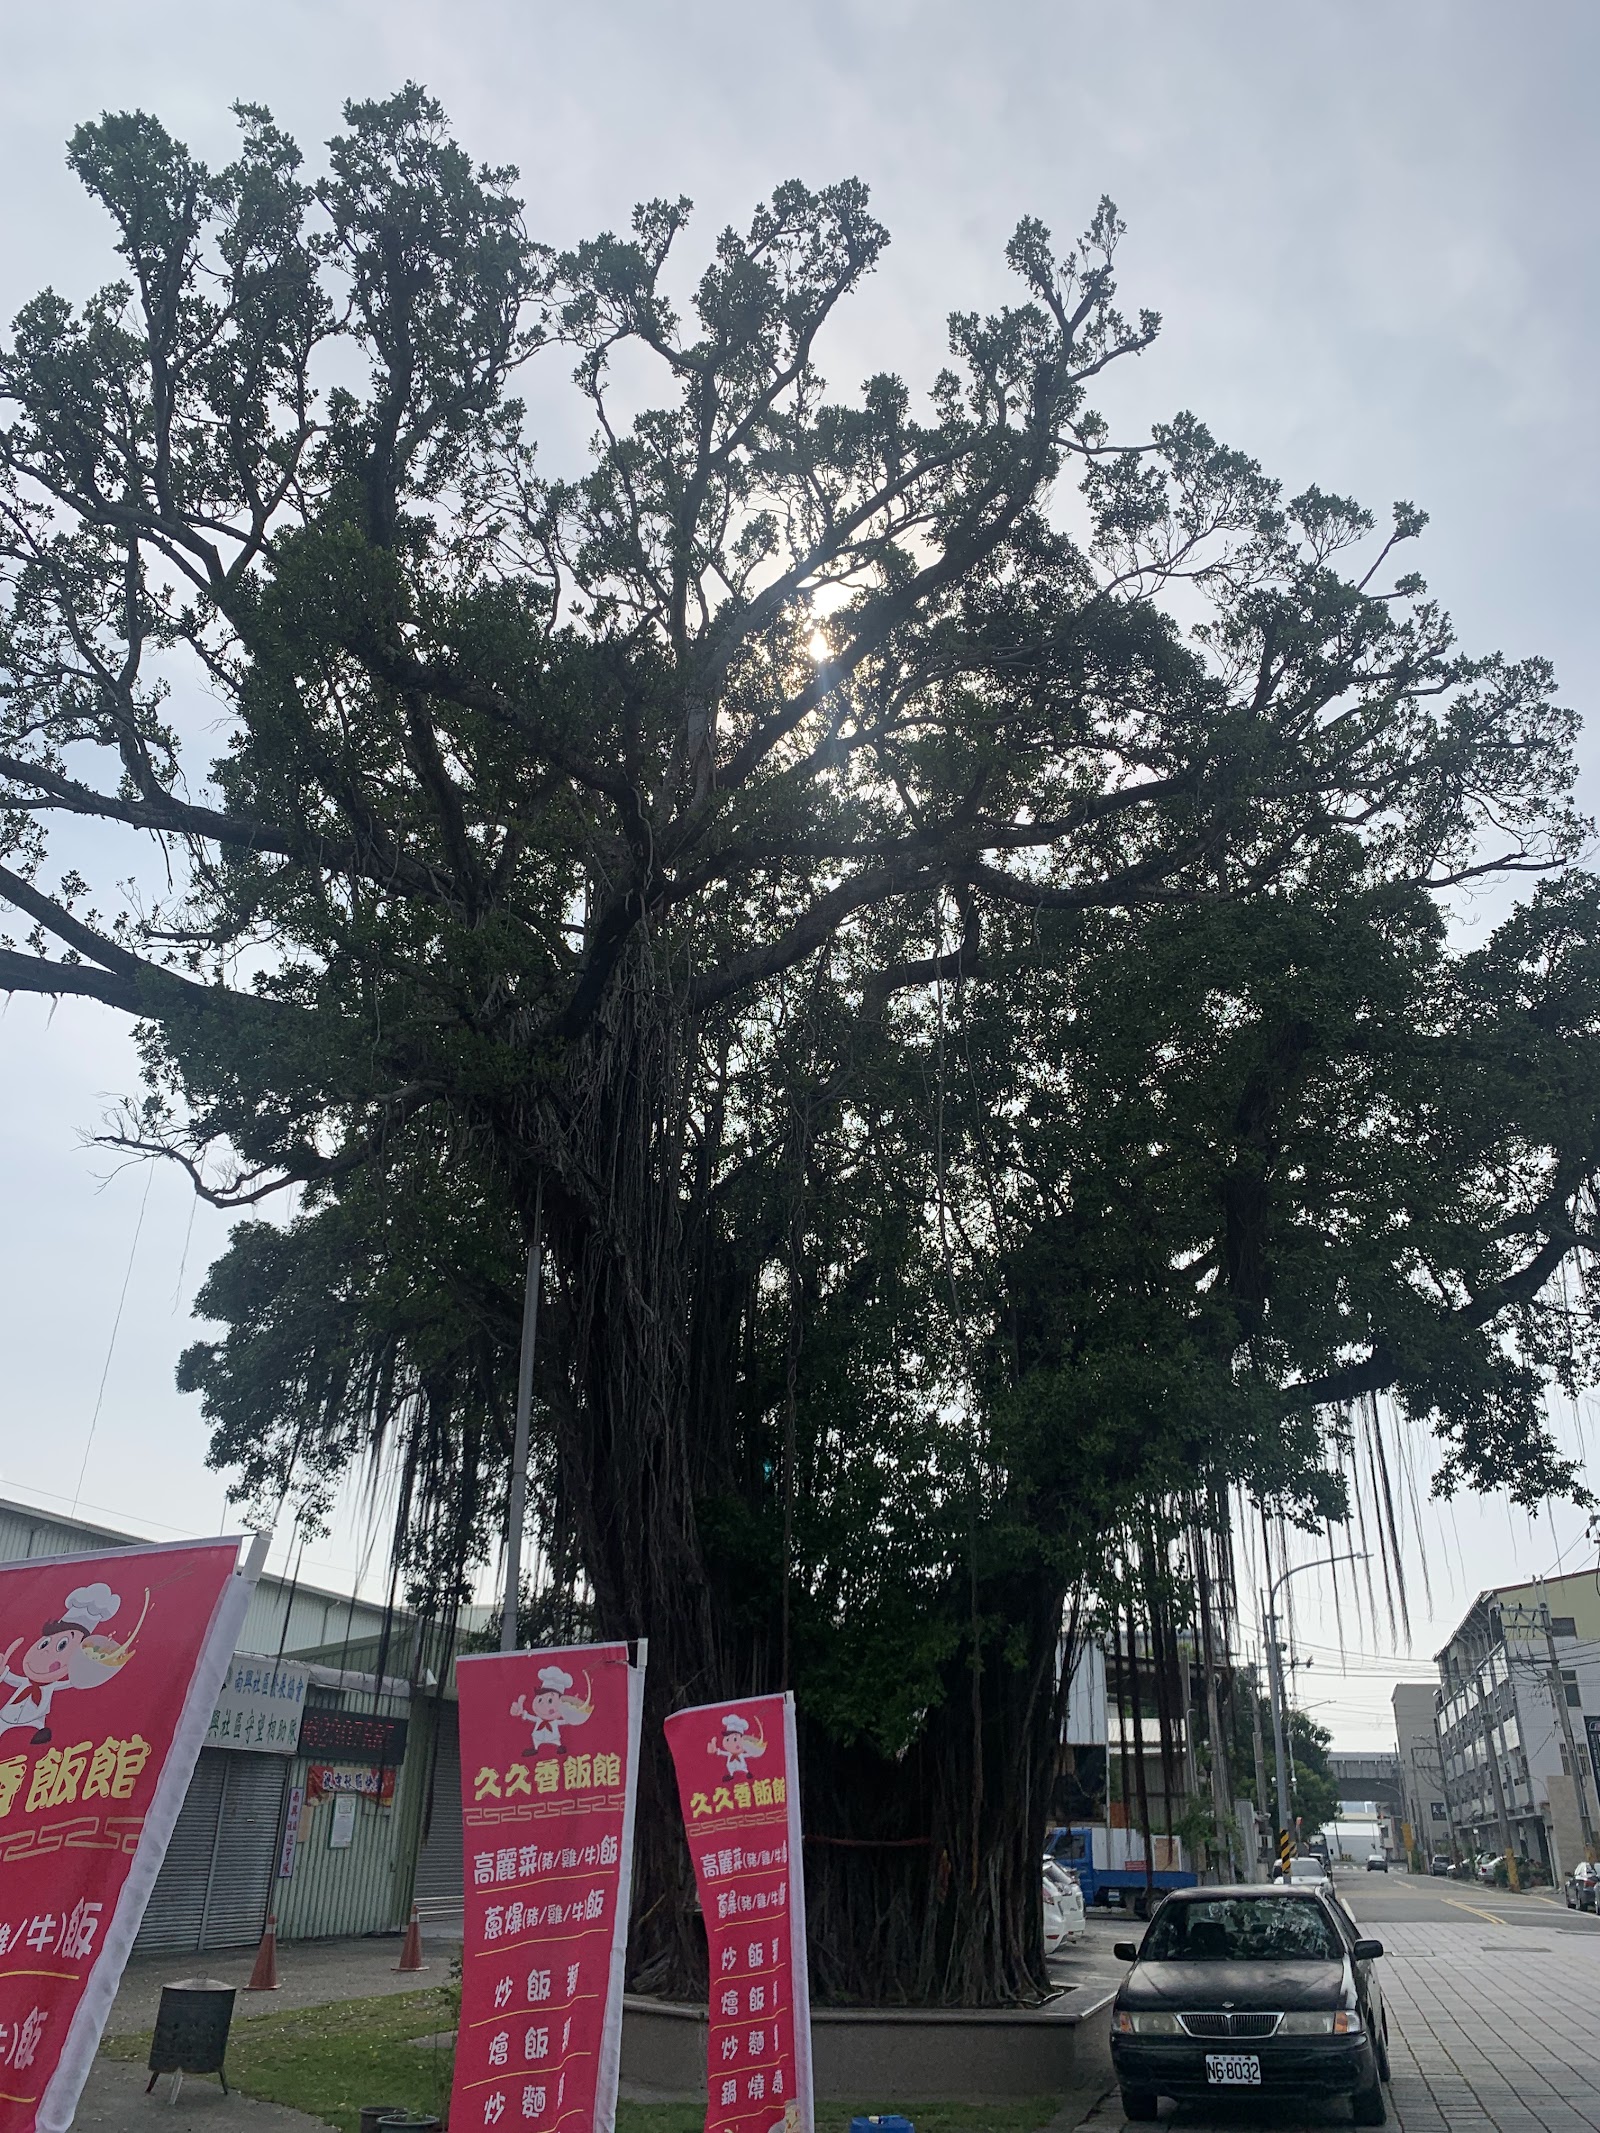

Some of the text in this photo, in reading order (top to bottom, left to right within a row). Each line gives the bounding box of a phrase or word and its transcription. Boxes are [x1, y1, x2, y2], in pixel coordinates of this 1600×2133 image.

[474, 1752, 621, 1801] 久久香飯館
